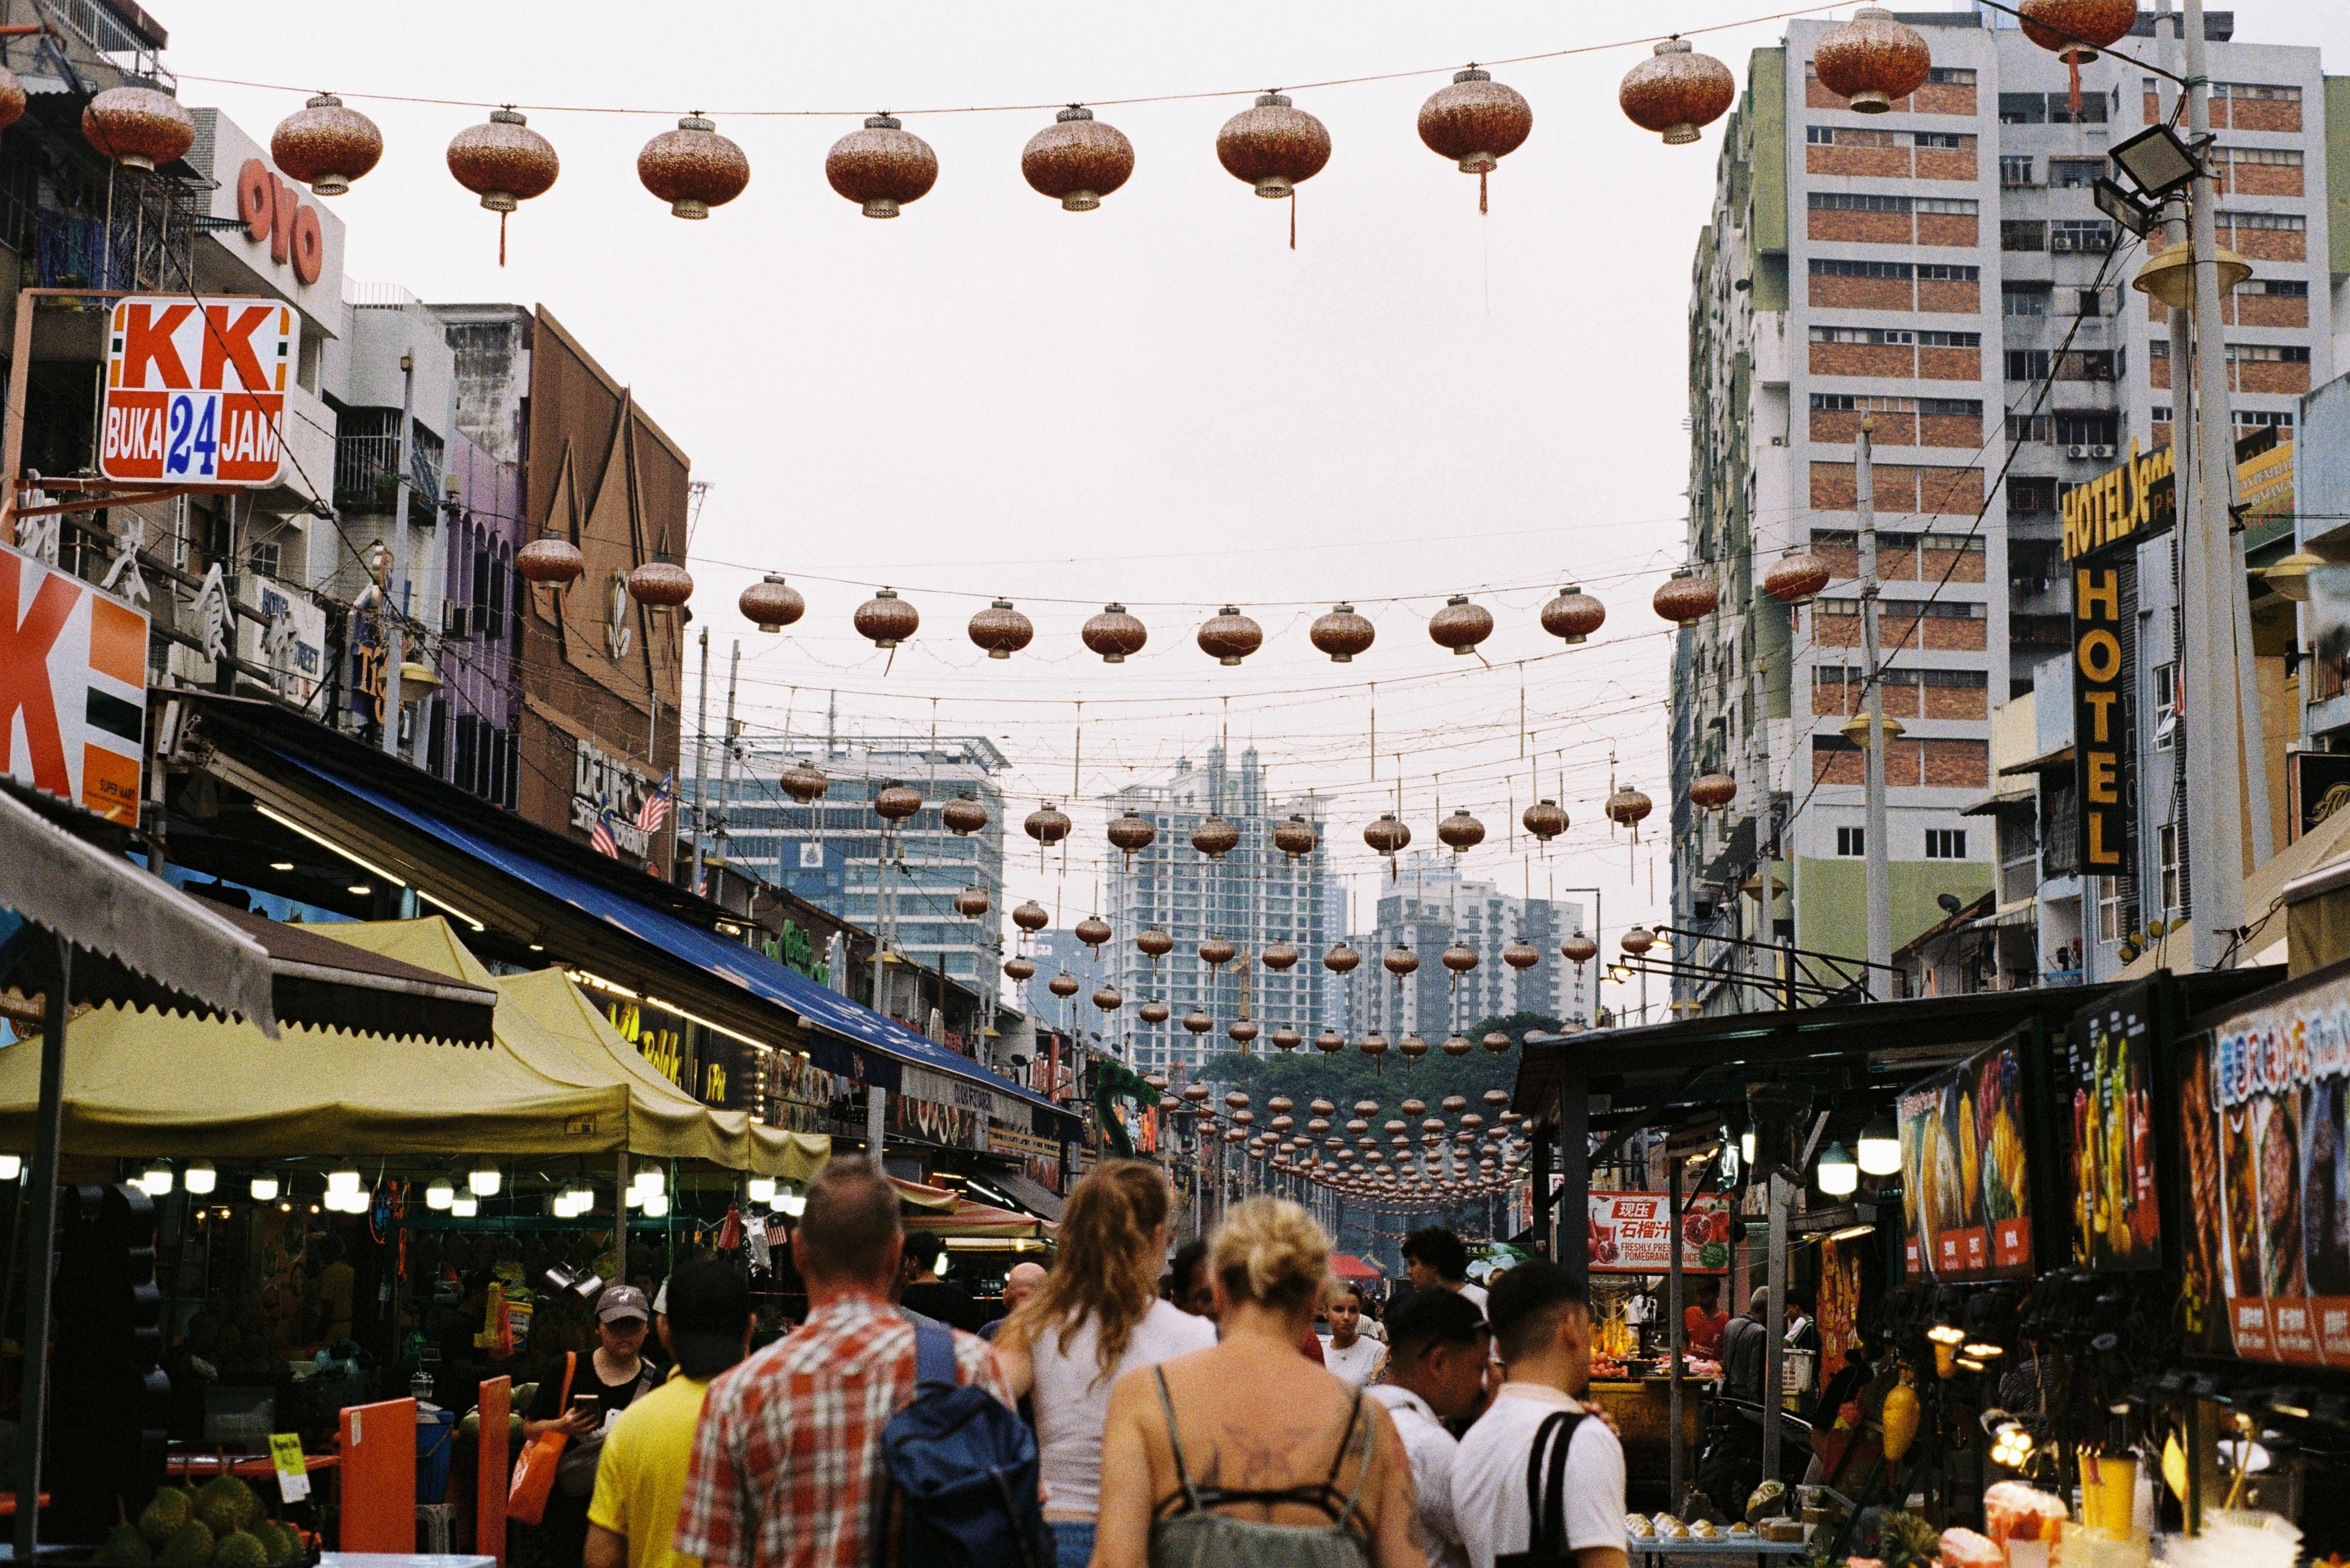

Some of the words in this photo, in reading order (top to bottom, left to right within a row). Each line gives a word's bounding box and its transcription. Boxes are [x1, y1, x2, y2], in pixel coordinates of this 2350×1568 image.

[237, 158, 323, 285] OYO
[122, 303, 275, 390] KK
[105, 407, 162, 461] BUKA
[166, 395, 217, 475] 24
[222, 410, 281, 462] JAM
[2063, 466, 2131, 562] HOTEL
[2077, 567, 2121, 865] HOTEL
[1619, 1202, 1649, 1217] 现压
[1620, 1220, 1670, 1239] 石榴汁
[1621, 1242, 1651, 1252] FRESHLY
[1682, 1253, 1699, 1262] UICE
